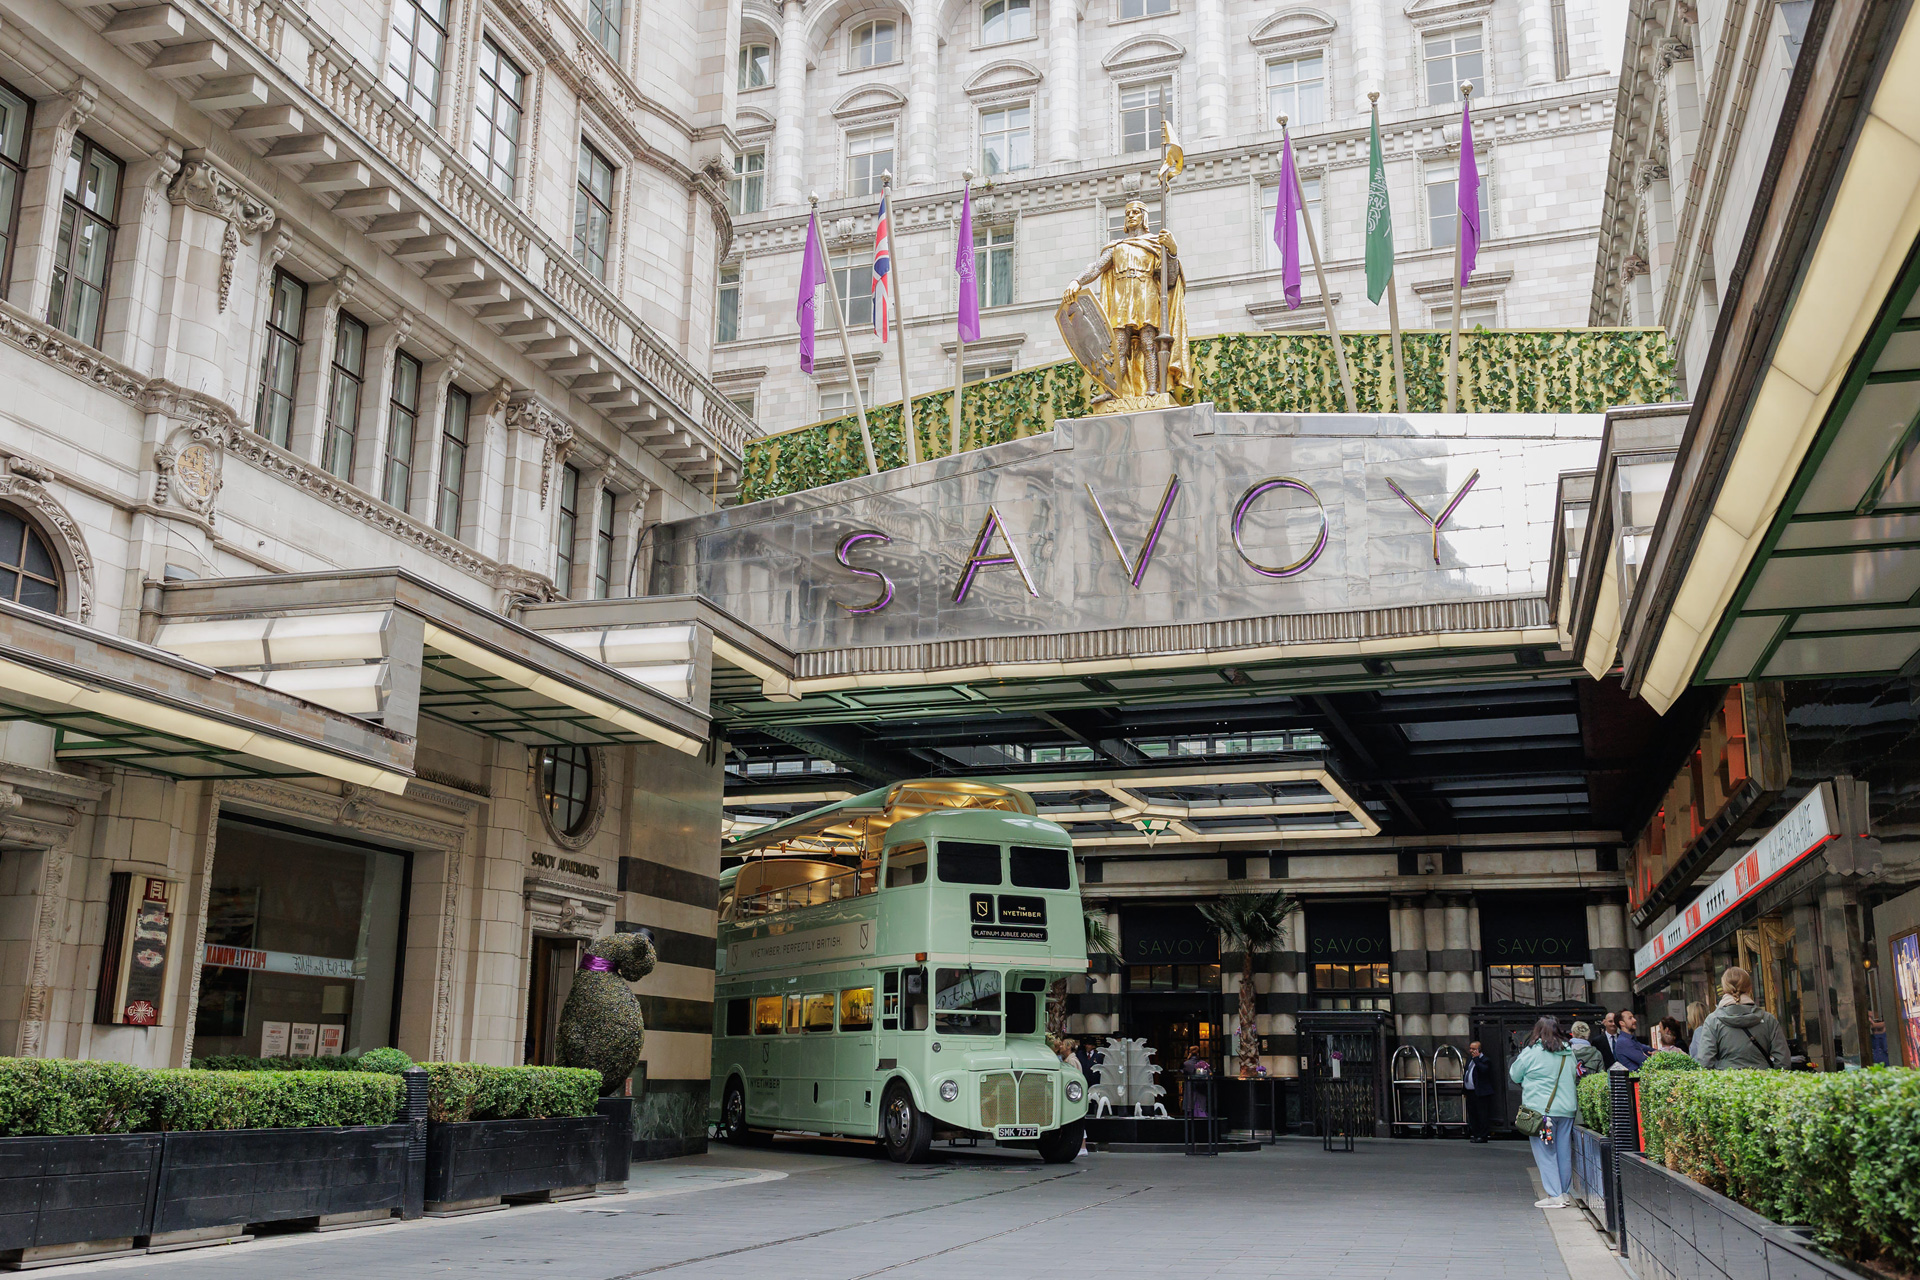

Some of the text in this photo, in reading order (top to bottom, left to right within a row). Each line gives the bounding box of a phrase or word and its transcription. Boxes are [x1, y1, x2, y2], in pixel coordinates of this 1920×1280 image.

[1106, 395, 1160, 412] SAVOY
[836, 468, 1480, 614] SAVOY
[531, 851, 557, 869] SAVOY
[1002, 910, 1042, 918] NYETIMBER
[974, 929, 1044, 939] PLATINUM JUBILEE JOURNEY
[782, 940, 815, 955] PERFECTLY
[816, 936, 843, 950] BRITISH.
[1138, 939, 1205, 955] SAVOY
[1313, 937, 1385, 954] SAVOY
[1497, 938, 1572, 955] SAVOY
[999, 1128, 1037, 1137] SMK 757F
